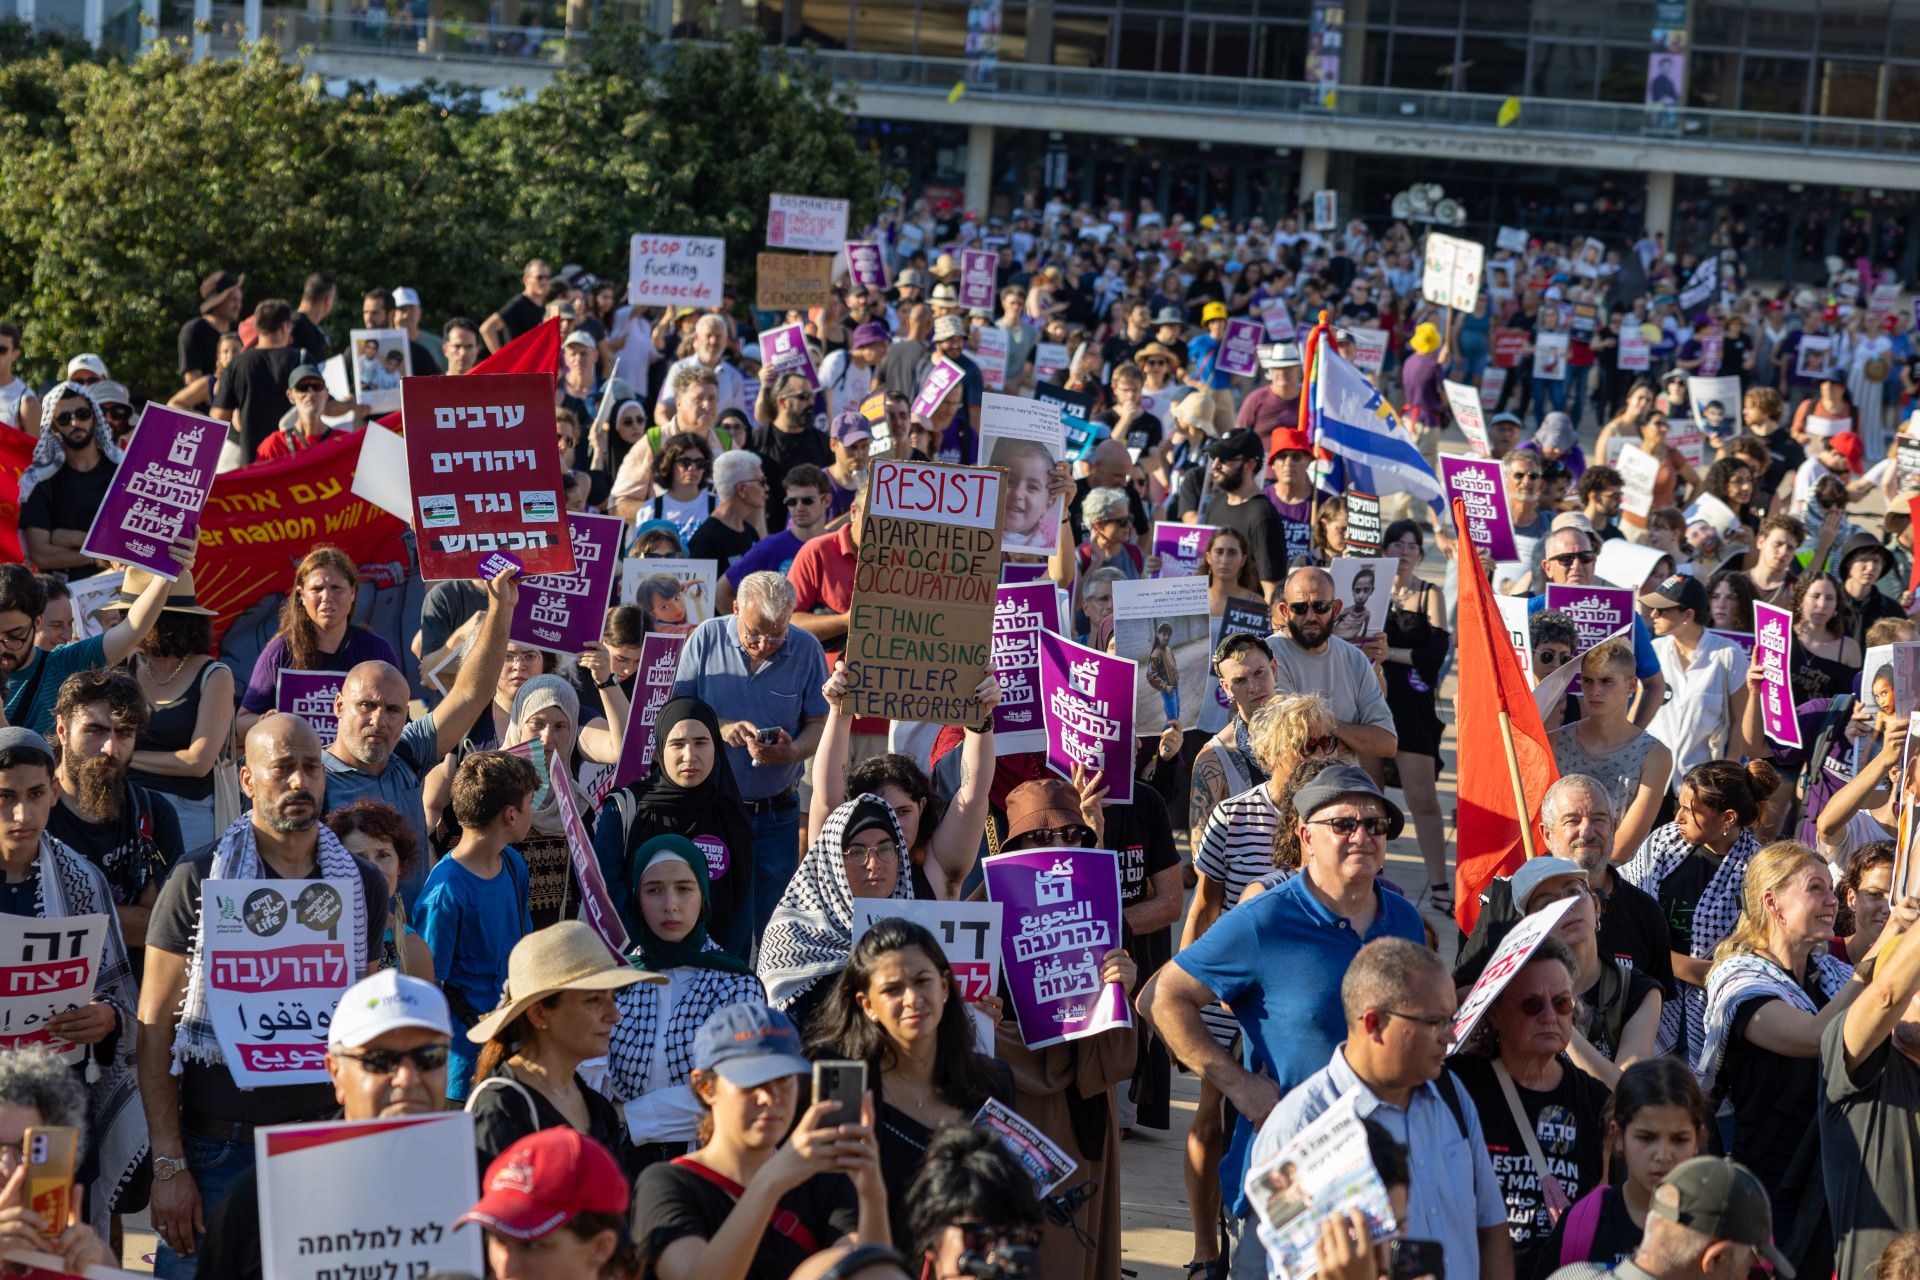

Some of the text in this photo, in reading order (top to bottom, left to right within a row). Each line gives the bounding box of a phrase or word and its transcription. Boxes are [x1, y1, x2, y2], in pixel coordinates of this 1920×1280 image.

[686, 239, 714, 258] this
[644, 258, 698, 280] fucking
[761, 256, 822, 272] RESIST
[640, 280, 711, 298] Genocide
[762, 291, 827, 305] GENOCIDE
[434, 405, 525, 429] ערבים
[176, 446, 193, 460] די
[431, 450, 537, 473] ויהודים
[144, 462, 201, 486] التجويع
[1454, 479, 1492, 491] מסרבים
[132, 477, 201, 507] להרעבה
[289, 476, 342, 505] עם
[876, 464, 998, 517] RESIST
[132, 498, 161, 518] غزة
[465, 493, 513, 513] נגד
[1466, 506, 1493, 517] לכיבו
[229, 516, 316, 545] nation
[439, 531, 548, 553] הכיבוש
[862, 517, 994, 553] APARTHEID
[860, 543, 986, 577] GENOCIDE
[857, 563, 993, 603] OCCUPATION
[539, 591, 567, 611] غزة
[1570, 594, 1611, 609] نرفض
[534, 607, 567, 624] עזה
[854, 604, 945, 637] ETHNIC
[995, 615, 1039, 632] מסרב
[861, 633, 987, 667] CLEANSING
[847, 660, 958, 694] SETTLER
[1000, 670, 1027, 691] غزة
[1073, 675, 1091, 692] די
[298, 701, 335, 713] רבים
[847, 690, 982, 721] TERRORISM
[1057, 686, 1109, 717] التجويع
[1053, 698, 1117, 738] להרעבה
[1036, 857, 1074, 882] كفى
[1127, 849, 1144, 867] אין
[1126, 866, 1144, 883] עם
[1042, 882, 1065, 898] די
[251, 894, 273, 912] חיים
[255, 915, 280, 934] Life
[1020, 901, 1093, 937] التجويع
[22, 929, 89, 962] זה
[940, 921, 991, 960] די
[1018, 922, 1106, 957] להרעבה
[215, 949, 345, 988] להרעבה
[1034, 948, 1094, 980] في غزة
[10, 966, 84, 992] רצח
[1040, 972, 1094, 998] בעזה
[1538, 1122, 1576, 1141] סרבו
[1506, 1192, 1536, 1209] حياة
[298, 1226, 402, 1256] למלחמה
[411, 1221, 444, 1246] לא
